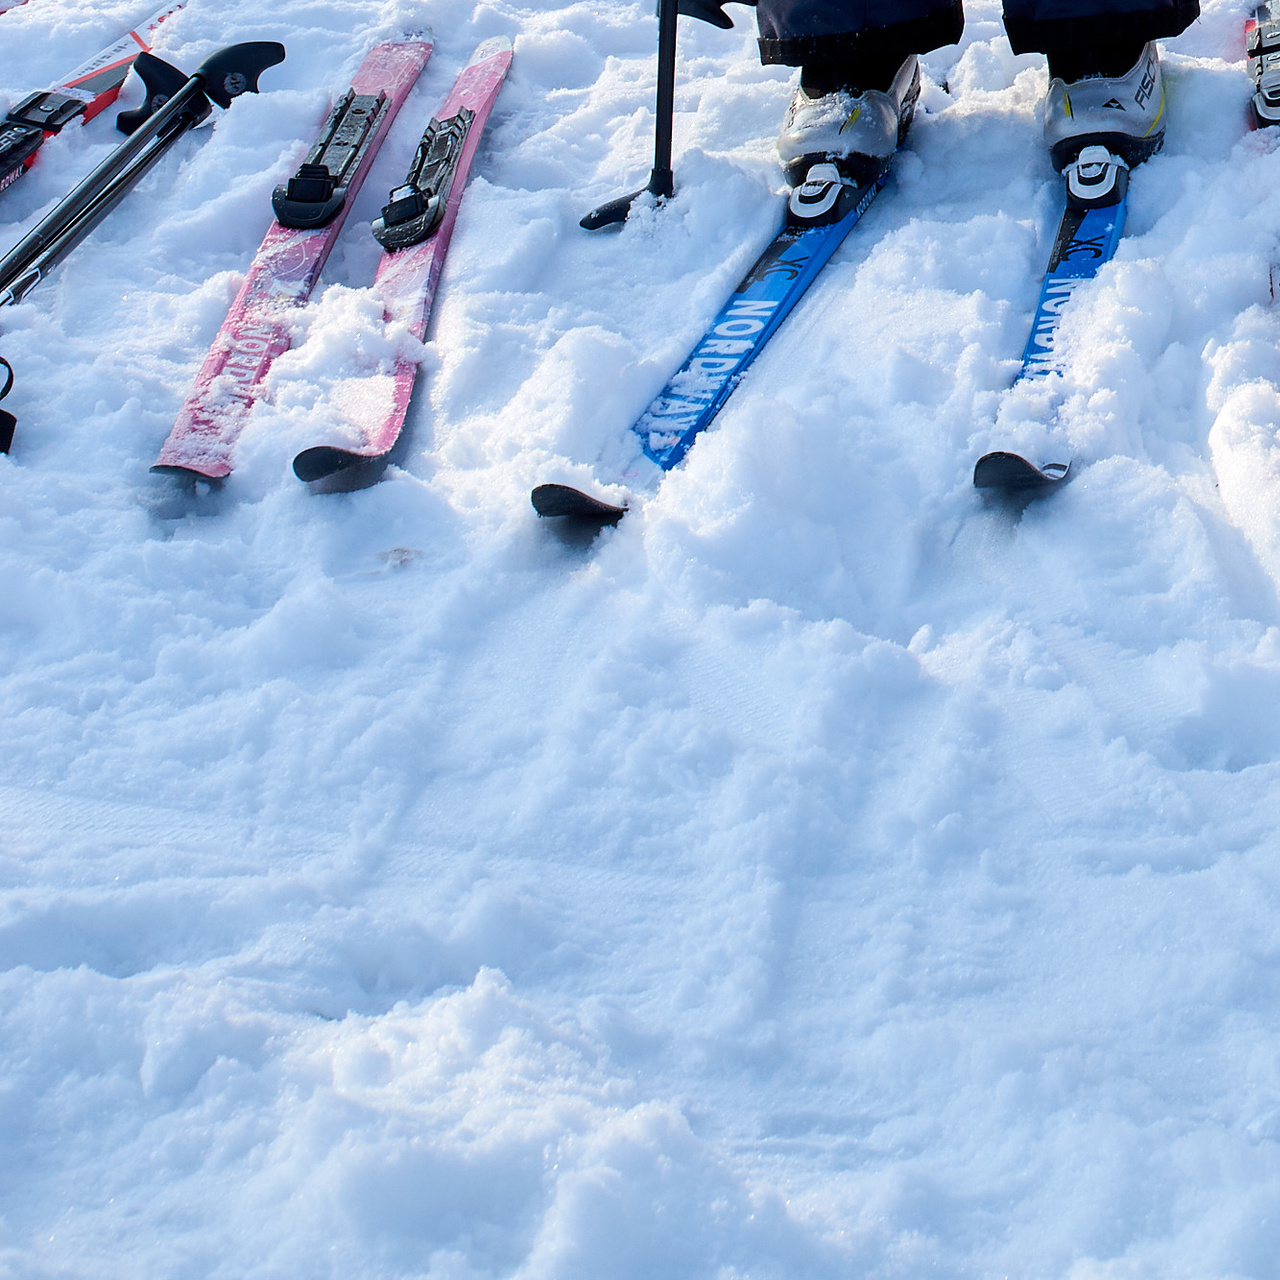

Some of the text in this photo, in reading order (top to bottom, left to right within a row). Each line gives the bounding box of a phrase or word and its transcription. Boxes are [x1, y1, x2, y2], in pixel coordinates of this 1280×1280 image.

[1061, 235, 1106, 262] XC
[763, 255, 810, 282] XC
[650, 300, 780, 431] NORDAY
